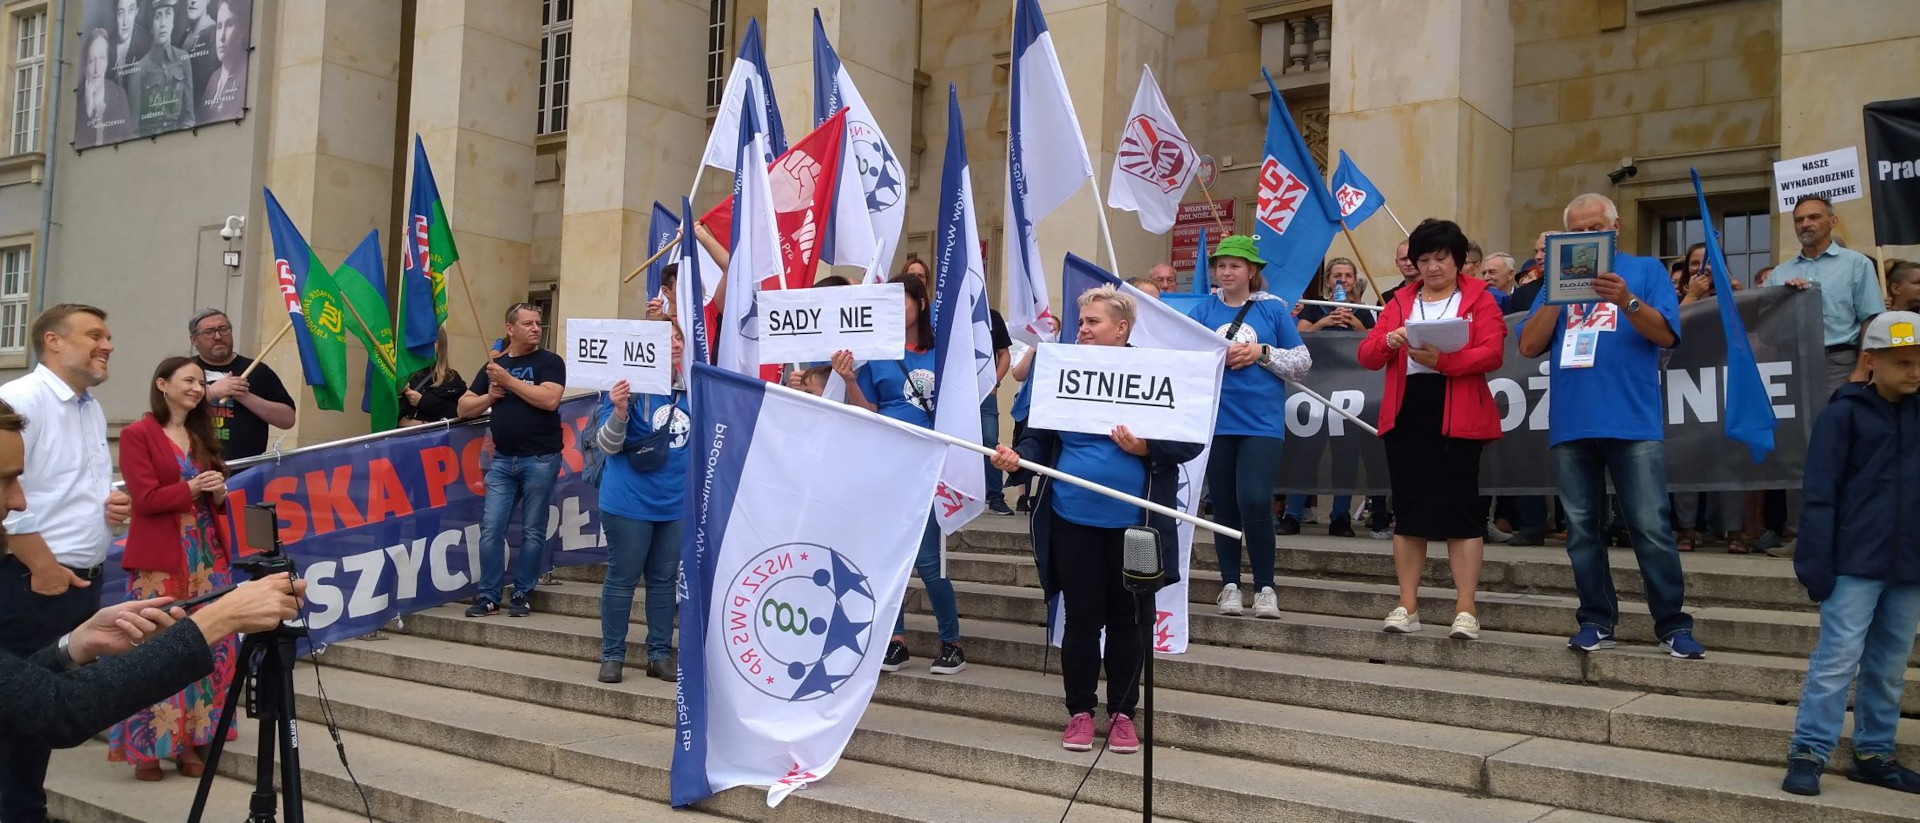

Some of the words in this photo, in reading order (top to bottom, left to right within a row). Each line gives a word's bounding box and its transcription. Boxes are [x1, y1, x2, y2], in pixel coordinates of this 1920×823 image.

[1802, 158, 1829, 171] NASZE
[1780, 169, 1855, 191] WYNAGRODZENIE
[1784, 196, 1795, 206] TO
[840, 306, 873, 328] NIE
[578, 338, 608, 360] BEZ
[624, 341, 656, 363] NAS
[1058, 369, 1175, 409] ISTNIEJĄ
[1284, 389, 1365, 438] OP
